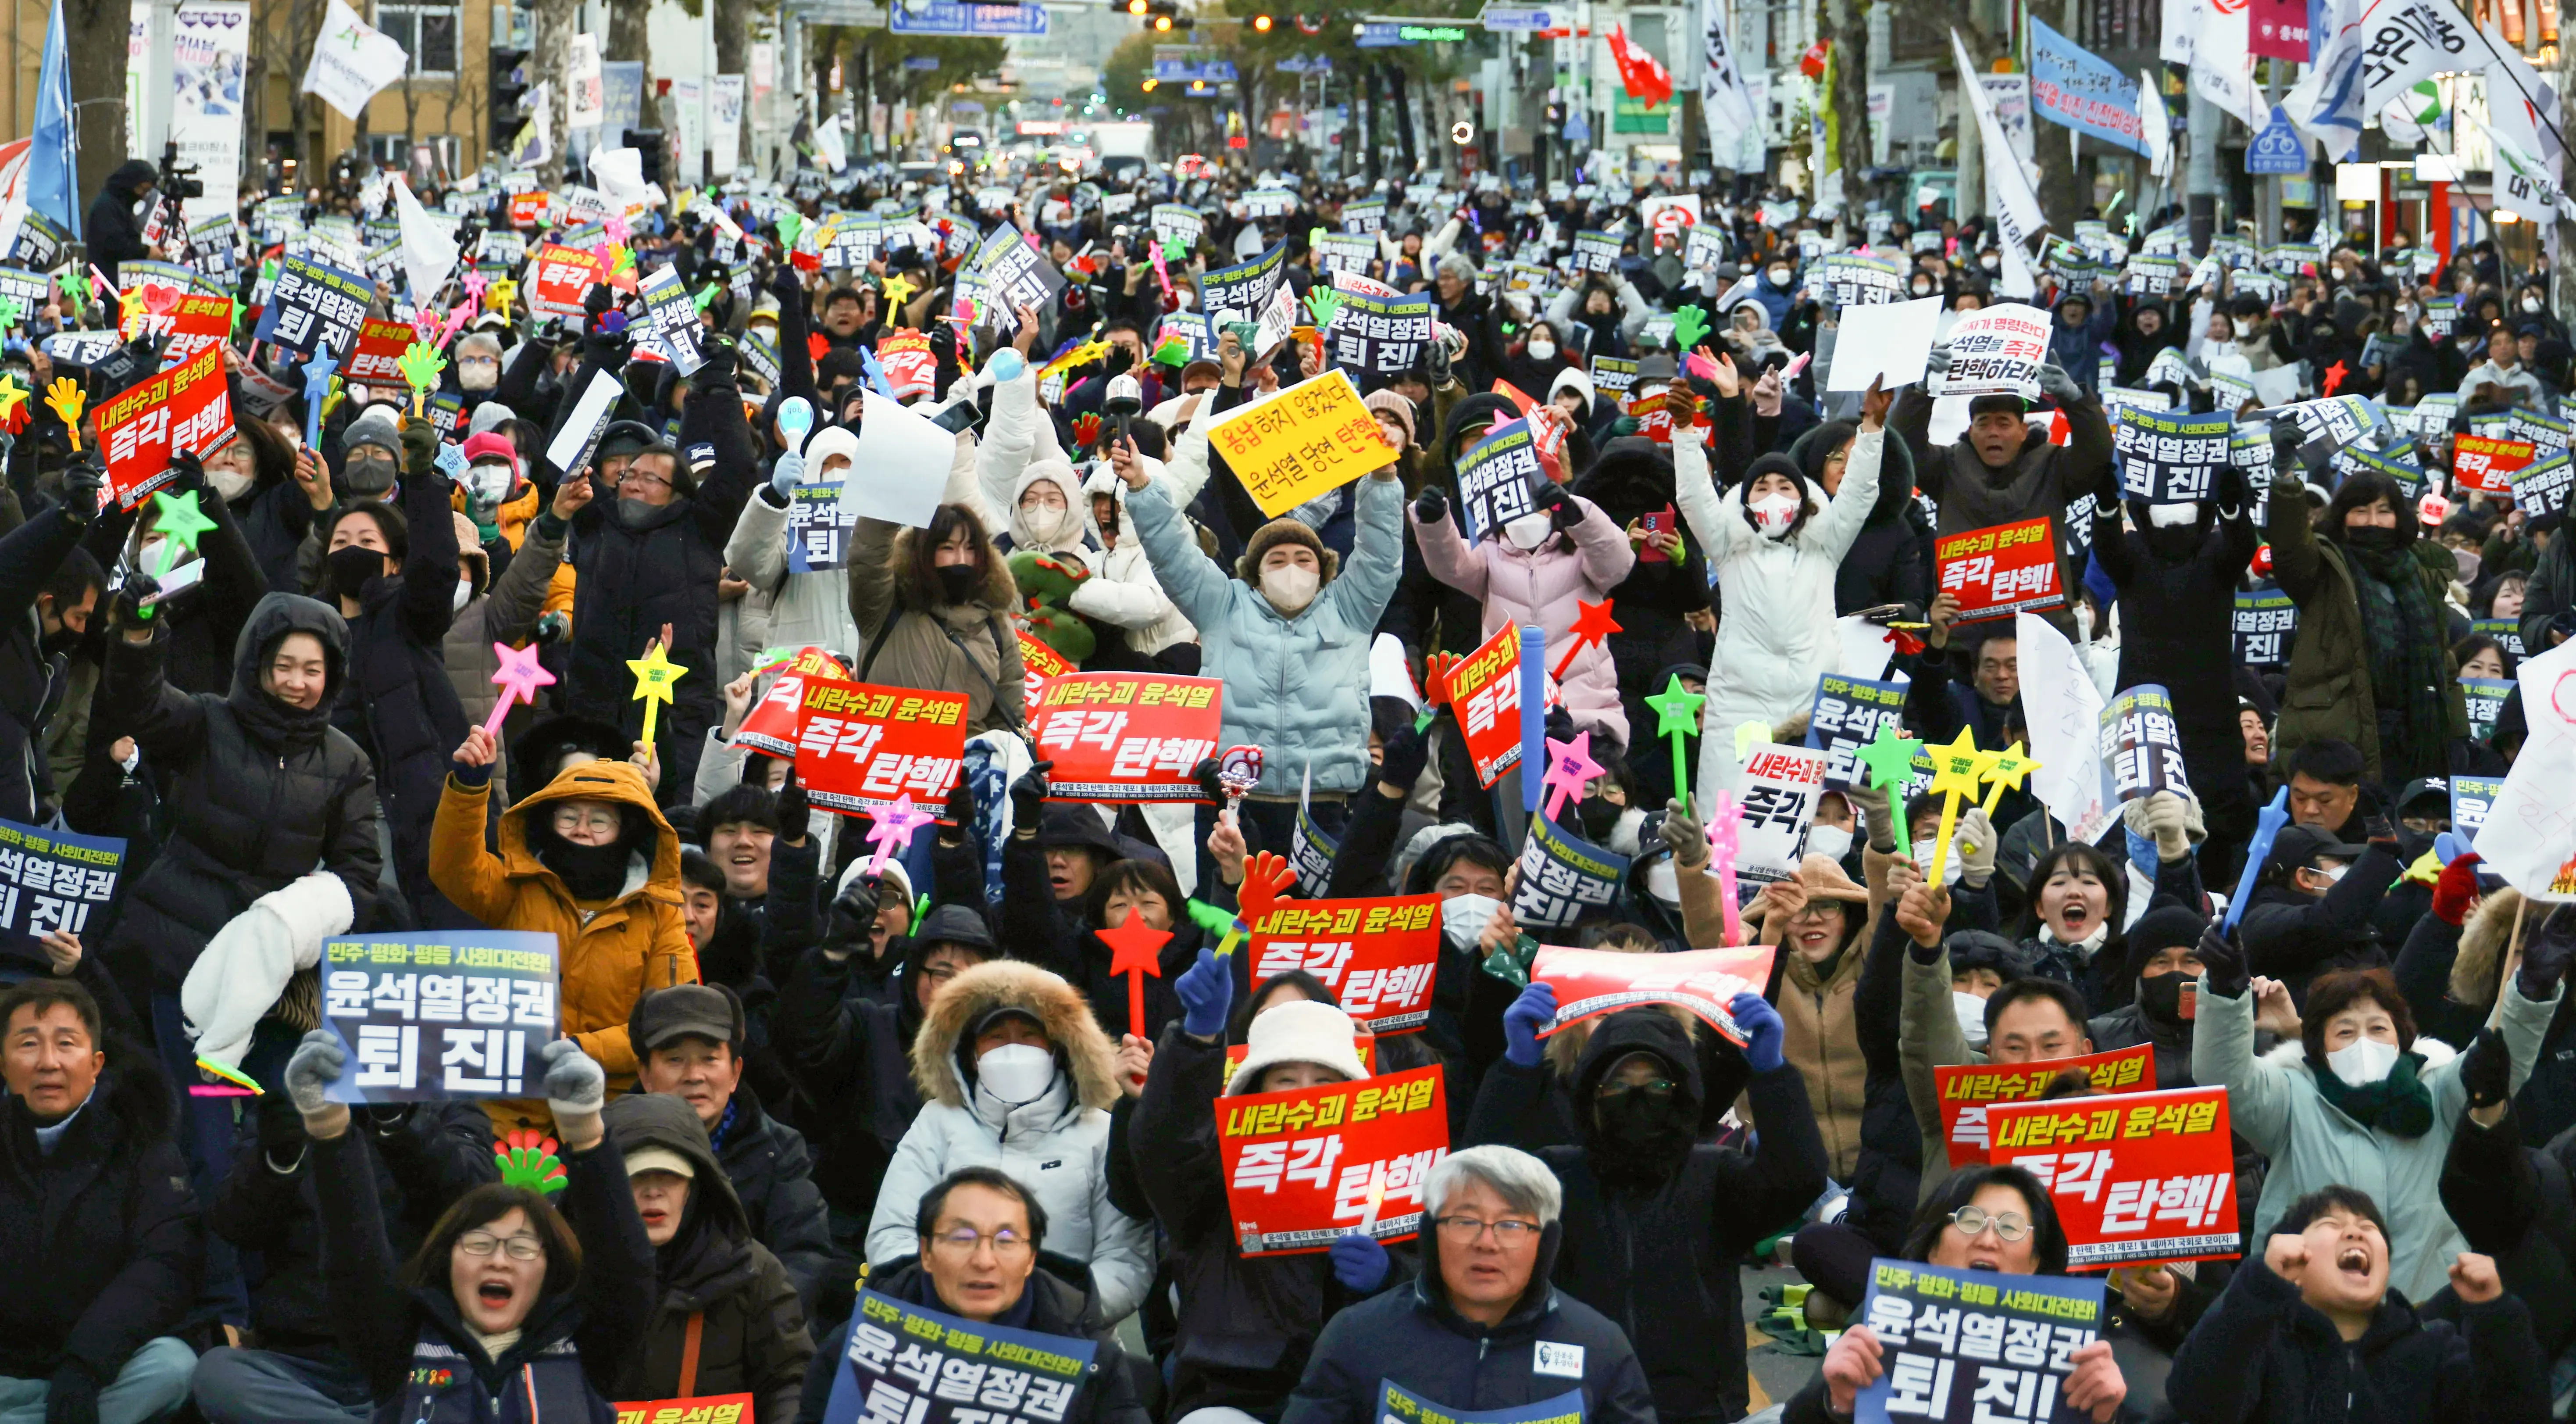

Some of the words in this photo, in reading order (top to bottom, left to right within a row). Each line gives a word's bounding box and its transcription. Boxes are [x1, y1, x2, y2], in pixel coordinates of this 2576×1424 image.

[540, 263, 591, 290] 즉각
[274, 272, 367, 331] 윤석열정권
[272, 304, 316, 346] 퇴
[1331, 307, 1431, 342] 윤석열정권
[1994, 318, 2046, 340] 명령한다
[670, 328, 700, 365] 퇴
[1336, 333, 1368, 368] 퇴
[1377, 341, 1419, 372] 진!
[2003, 340, 2044, 361] 즉각
[101, 379, 169, 432] 내란수괴
[174, 348, 217, 396] 윤석열
[1945, 358, 2038, 385] 탄핵하라!
[1293, 377, 1352, 419] 않겠다
[110, 405, 171, 465] 즉각
[171, 390, 227, 459] 탄핵!
[2115, 423, 2229, 464] 윤석열정권
[2178, 421, 2229, 435] 사회대전환!
[447, 454, 462, 469] OUT
[1250, 452, 1309, 500] 윤석열
[1299, 436, 1344, 472] 당연
[1460, 444, 1538, 505] 윤석열정권
[2123, 456, 2156, 498] 퇴
[2167, 466, 2212, 500] 진!
[2455, 452, 2492, 474] 즉각
[2512, 462, 2575, 501] 윤석열정권
[1472, 493, 1490, 538] 퇴
[1492, 477, 1533, 523] 진!
[2524, 492, 2546, 519] 퇴
[806, 529, 838, 563] 퇴
[1939, 533, 1995, 560] 내란수괴
[1998, 524, 2046, 548] 윤석열
[1942, 555, 1995, 590] 즉각
[1991, 562, 2055, 601] 탄핵!
[2232, 608, 2295, 632] 열정권
[2244, 633, 2280, 663] 진!
[1453, 637, 1515, 703] 내란수괴
[804, 686, 896, 718] 내란수괴
[895, 697, 963, 725] 윤석열
[1045, 682, 1139, 706] 내란수괴
[1138, 683, 1214, 708] 윤석열
[1467, 664, 1521, 737] 즉각
[1822, 677, 1900, 706] 민주·평화·평등
[799, 716, 884, 763] 즉각
[1040, 711, 1129, 750] 즉각
[861, 753, 961, 797] 탄핵!
[1110, 737, 1215, 776] 탄핵!
[1495, 752, 1510, 768] 윤석열
[1746, 751, 1813, 784] 내란수괴
[2114, 745, 2151, 796] 퇴
[830, 792, 841, 801] 즉각
[842, 794, 856, 804] 탄핵!
[857, 796, 871, 805] 즉각
[1742, 785, 1806, 834] 즉각
[52, 842, 119, 866] 사회대전환!
[29, 894, 89, 938] 진!
[1255, 909, 1361, 935] 내란수괴
[1363, 903, 1435, 934] 윤석열
[1512, 880, 1583, 927] 진!
[328, 943, 451, 965] 민주·평화·평등
[455, 947, 551, 973] 사회대전환!
[1256, 942, 1353, 986] 즉각
[326, 971, 555, 1026] 윤석열정권
[1341, 962, 1434, 1013] 탄핵!
[1374, 1017, 1389, 1027] 때까지
[1391, 1015, 1406, 1024] 국회로
[1407, 1012, 1425, 1021] 모이자!
[355, 1025, 419, 1089] 퇴
[442, 1029, 526, 1095] 진!
[1945, 1071, 2051, 1099] 내란수괴
[2080, 1055, 2145, 1088] 석열
[1225, 1094, 1346, 1136] 내란수괴
[1351, 1077, 1434, 1122] 윤석열
[1996, 1109, 2120, 1147] 내란수괴
[2123, 1101, 2218, 1138] 윤석열
[1233, 1134, 1343, 1194] 즉각
[2100, 1172, 2230, 1234] 탄핵!
[1267, 1233, 1292, 1242] 윤석열
[1293, 1231, 1310, 1240] 즉각
[1380, 1217, 1401, 1228] 때까지
[2076, 1244, 2096, 1256] 탄핵!
[2098, 1243, 2115, 1254] 즉각
[2118, 1242, 2137, 1252] 체포!
[2150, 1239, 2175, 1250] 때까지
[2178, 1237, 2202, 1248] 국회로
[2205, 1235, 2233, 1246] 모이자!
[1875, 1264, 1998, 1307] 민주·평화·평등
[2001, 1288, 2097, 1321] 사회대전환!
[860, 1295, 984, 1353] 민주·평화·평등
[984, 1339, 1082, 1376] 사회대전환!
[1867, 1295, 2096, 1372] 윤석열정권
[848, 1323, 1076, 1421] 윤석열정권
[1884, 1352, 1957, 1420] 퇴
[1973, 1366, 2060, 1424] 진!
